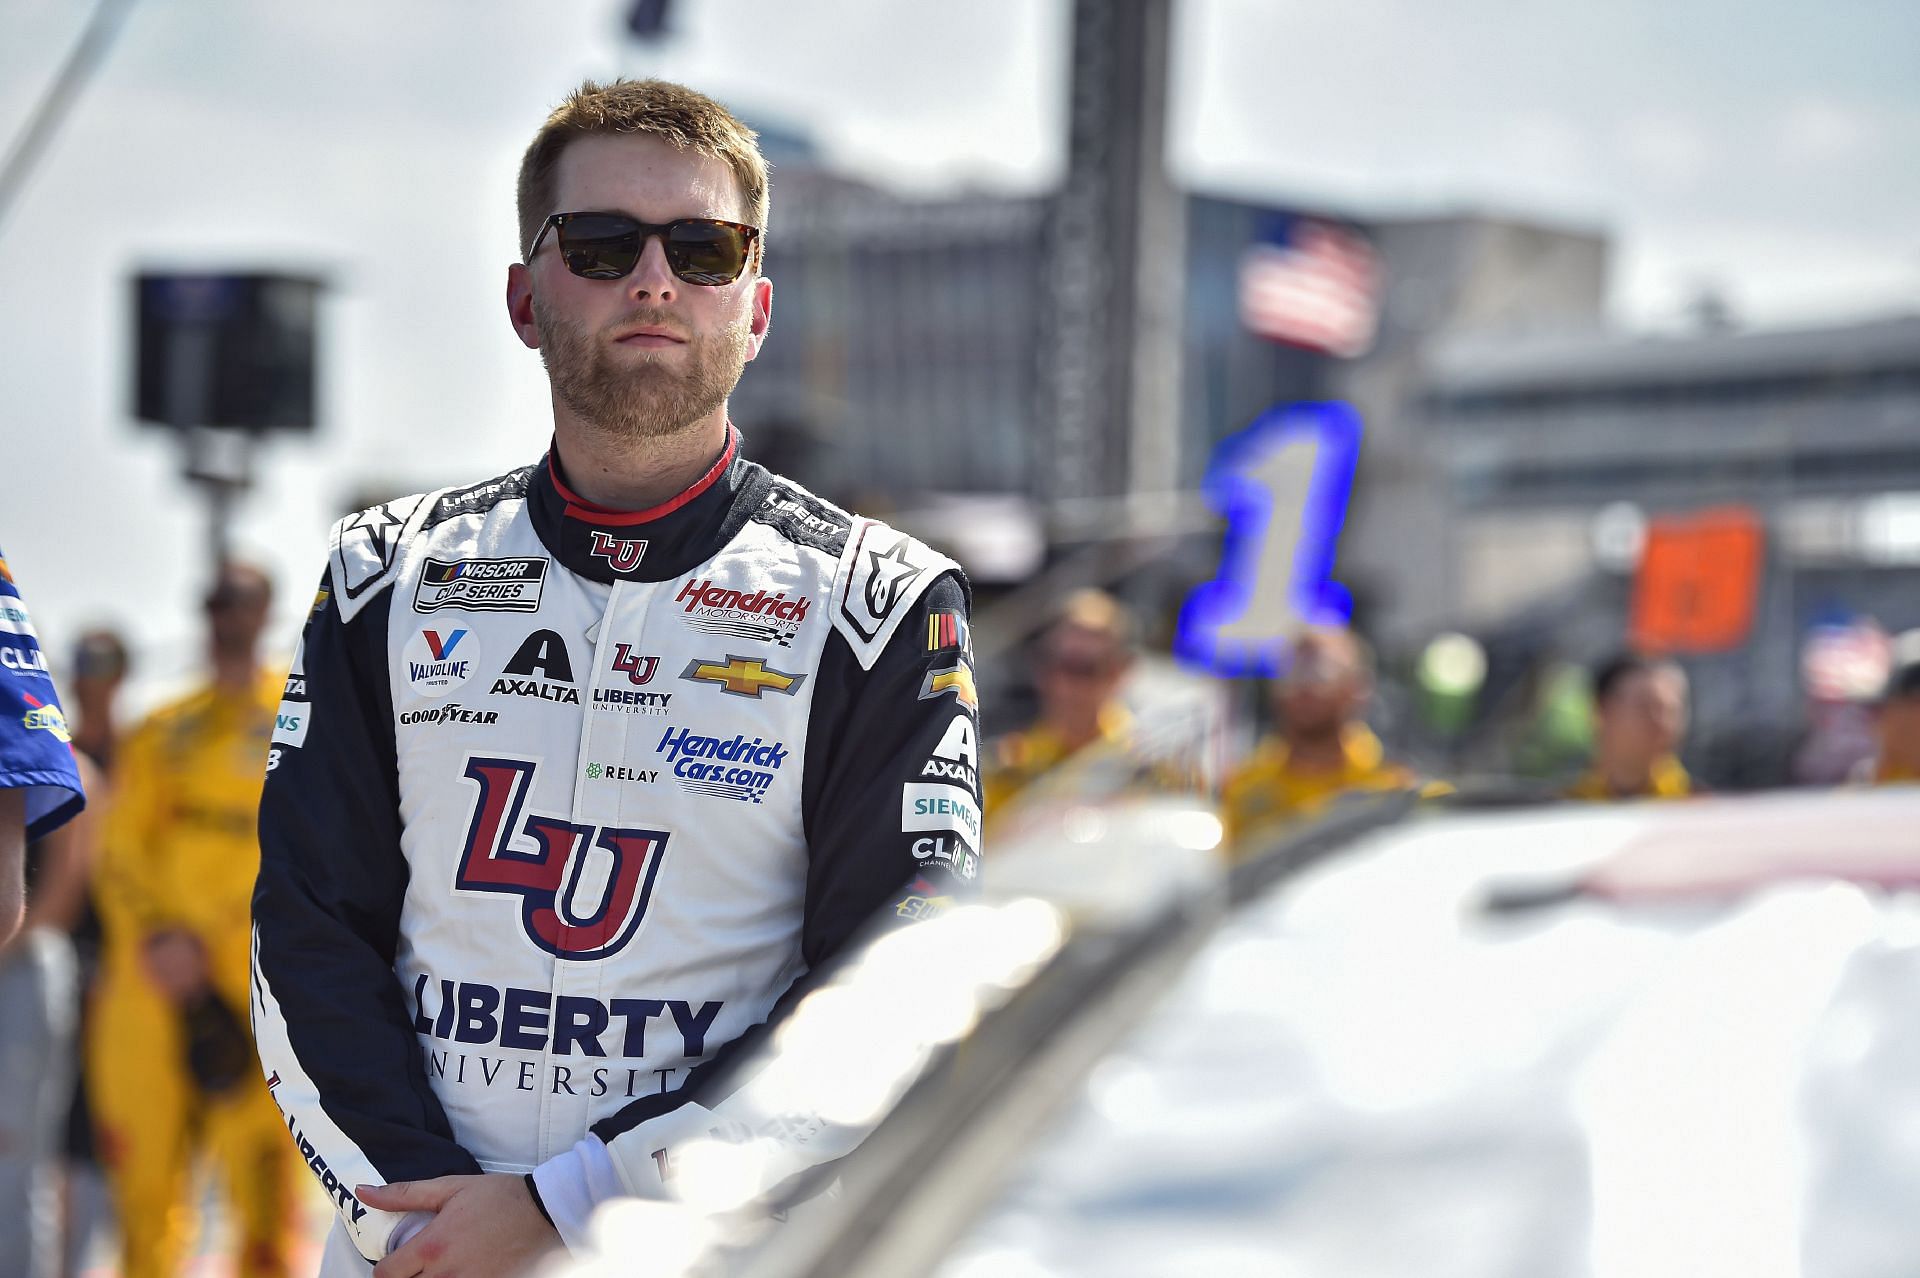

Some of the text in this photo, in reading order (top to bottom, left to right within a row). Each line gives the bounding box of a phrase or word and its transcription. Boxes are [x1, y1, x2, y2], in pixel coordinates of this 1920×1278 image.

[767, 493, 848, 536] LIBERTY
[1174, 400, 1364, 678] 1
[459, 562, 529, 578] NASCAR
[435, 582, 524, 600] CUP SERIES
[675, 578, 811, 622] Hendrick
[697, 607, 801, 632] MOTORSPORTS
[409, 661, 469, 682] VALVOLINE
[489, 678, 580, 705] AXALTA
[593, 688, 673, 708] LIBERTY
[592, 703, 671, 716] UNIVERSITY
[656, 727, 789, 769] Hendrick
[605, 766, 659, 783] RELAY
[673, 758, 774, 789] Cars.com
[914, 798, 977, 836] SIEMENS
[455, 756, 671, 961] LU
[414, 974, 724, 1058] LIBERTY
[424, 1047, 690, 1098] NIVERSIT
